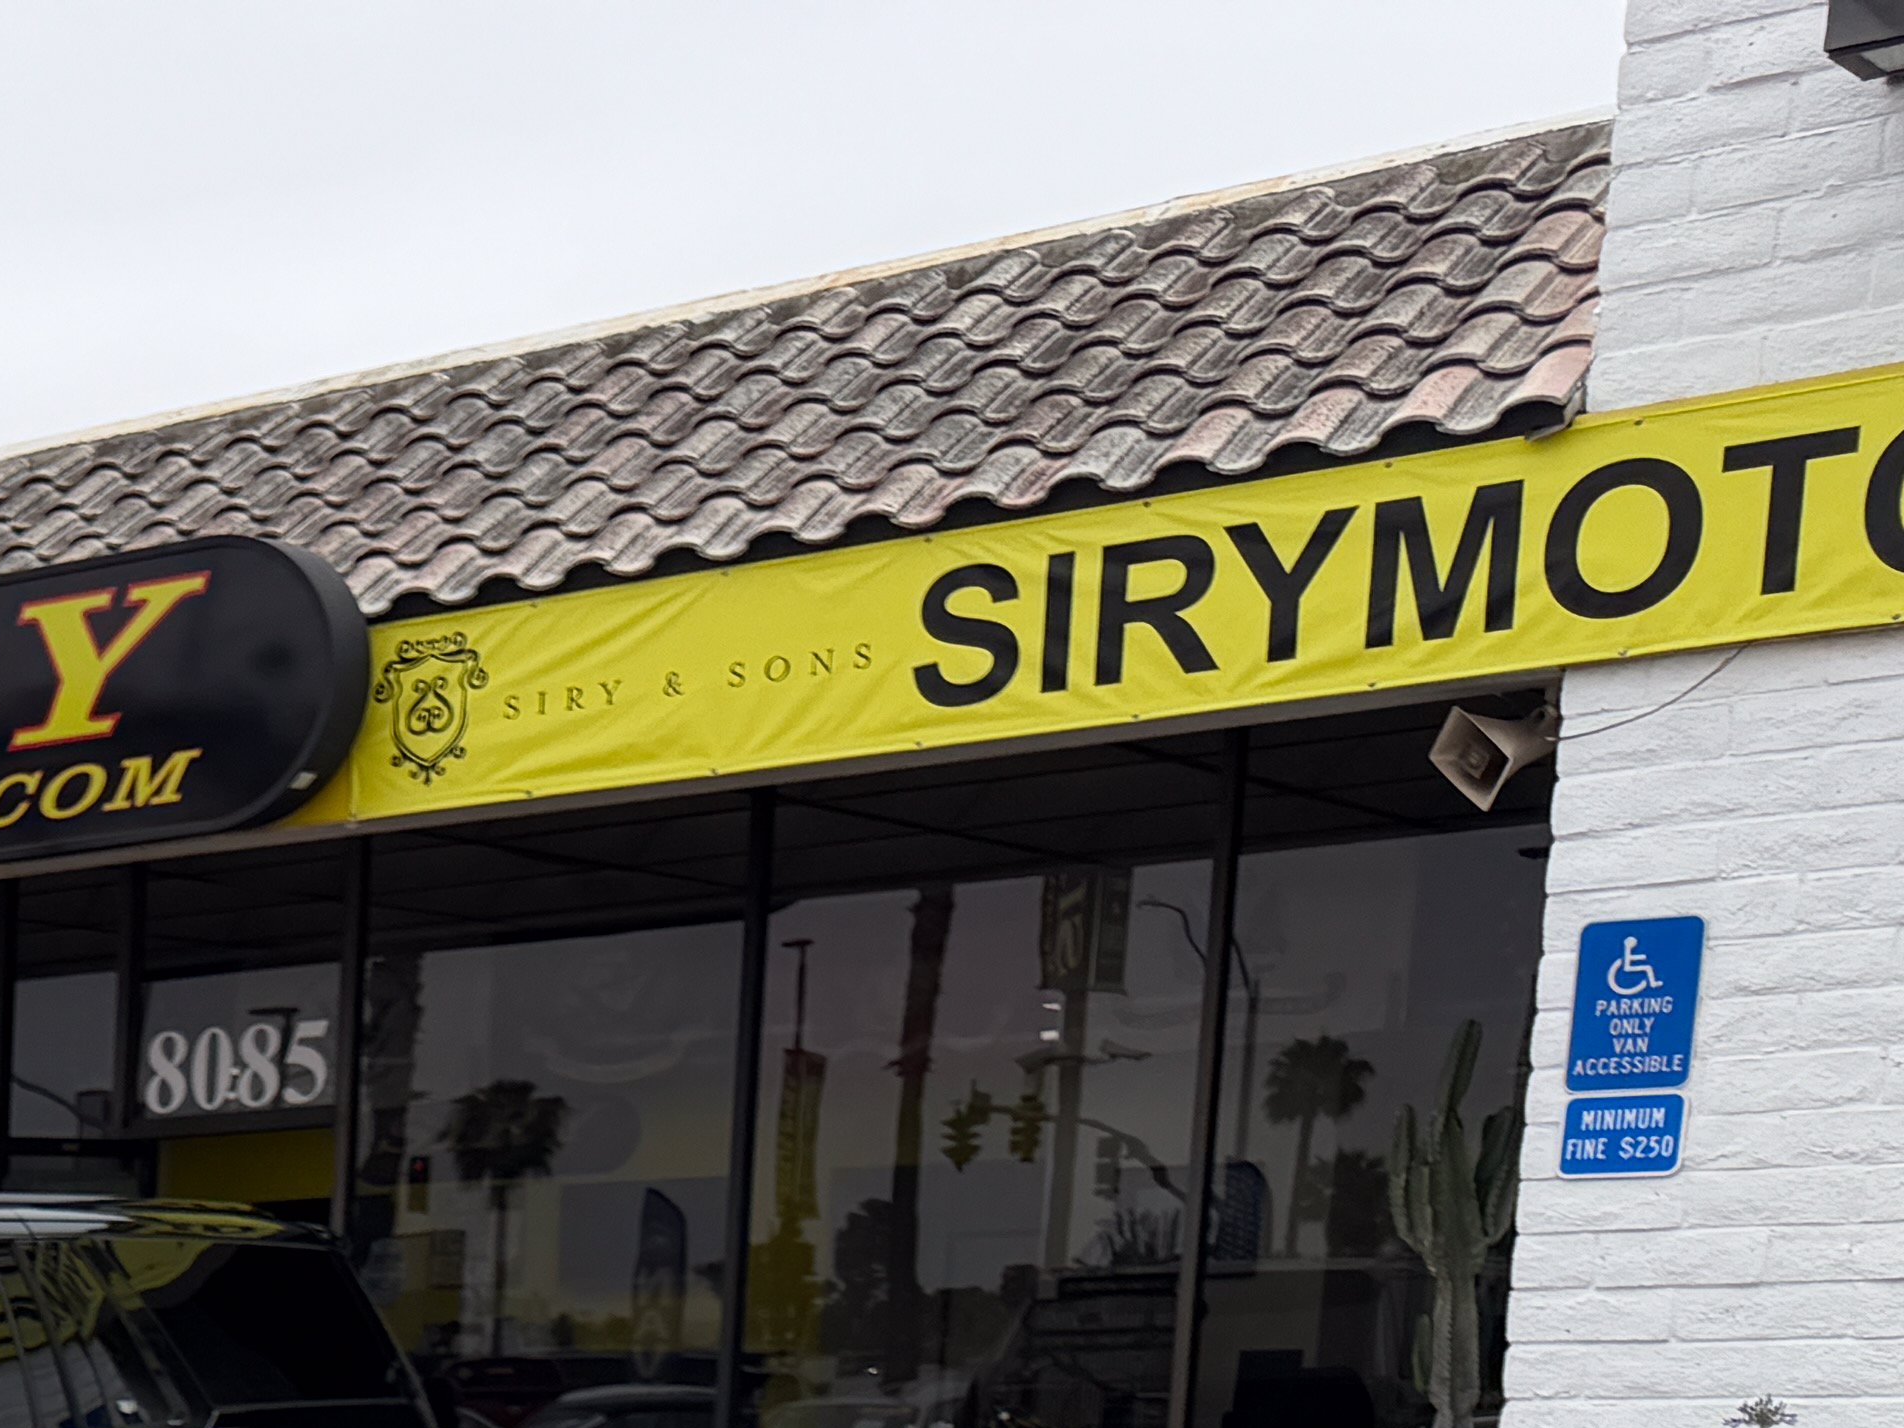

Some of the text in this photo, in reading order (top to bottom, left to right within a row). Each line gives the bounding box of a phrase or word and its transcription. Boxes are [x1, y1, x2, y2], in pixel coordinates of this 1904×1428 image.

[912, 424, 1904, 709] SIRYMOT
[502, 641, 873, 720] SIRY & SONS
[1594, 996, 1674, 1017] PARKING
[1609, 1017, 1655, 1036] ONLY
[1612, 1036, 1649, 1055] VAN
[145, 1019, 329, 1115] 8085
[1572, 1054, 1685, 1077] ACCESSIBLE
[1580, 1107, 1666, 1132] MINIMUM
[1565, 1134, 1675, 1160] FINE $250
